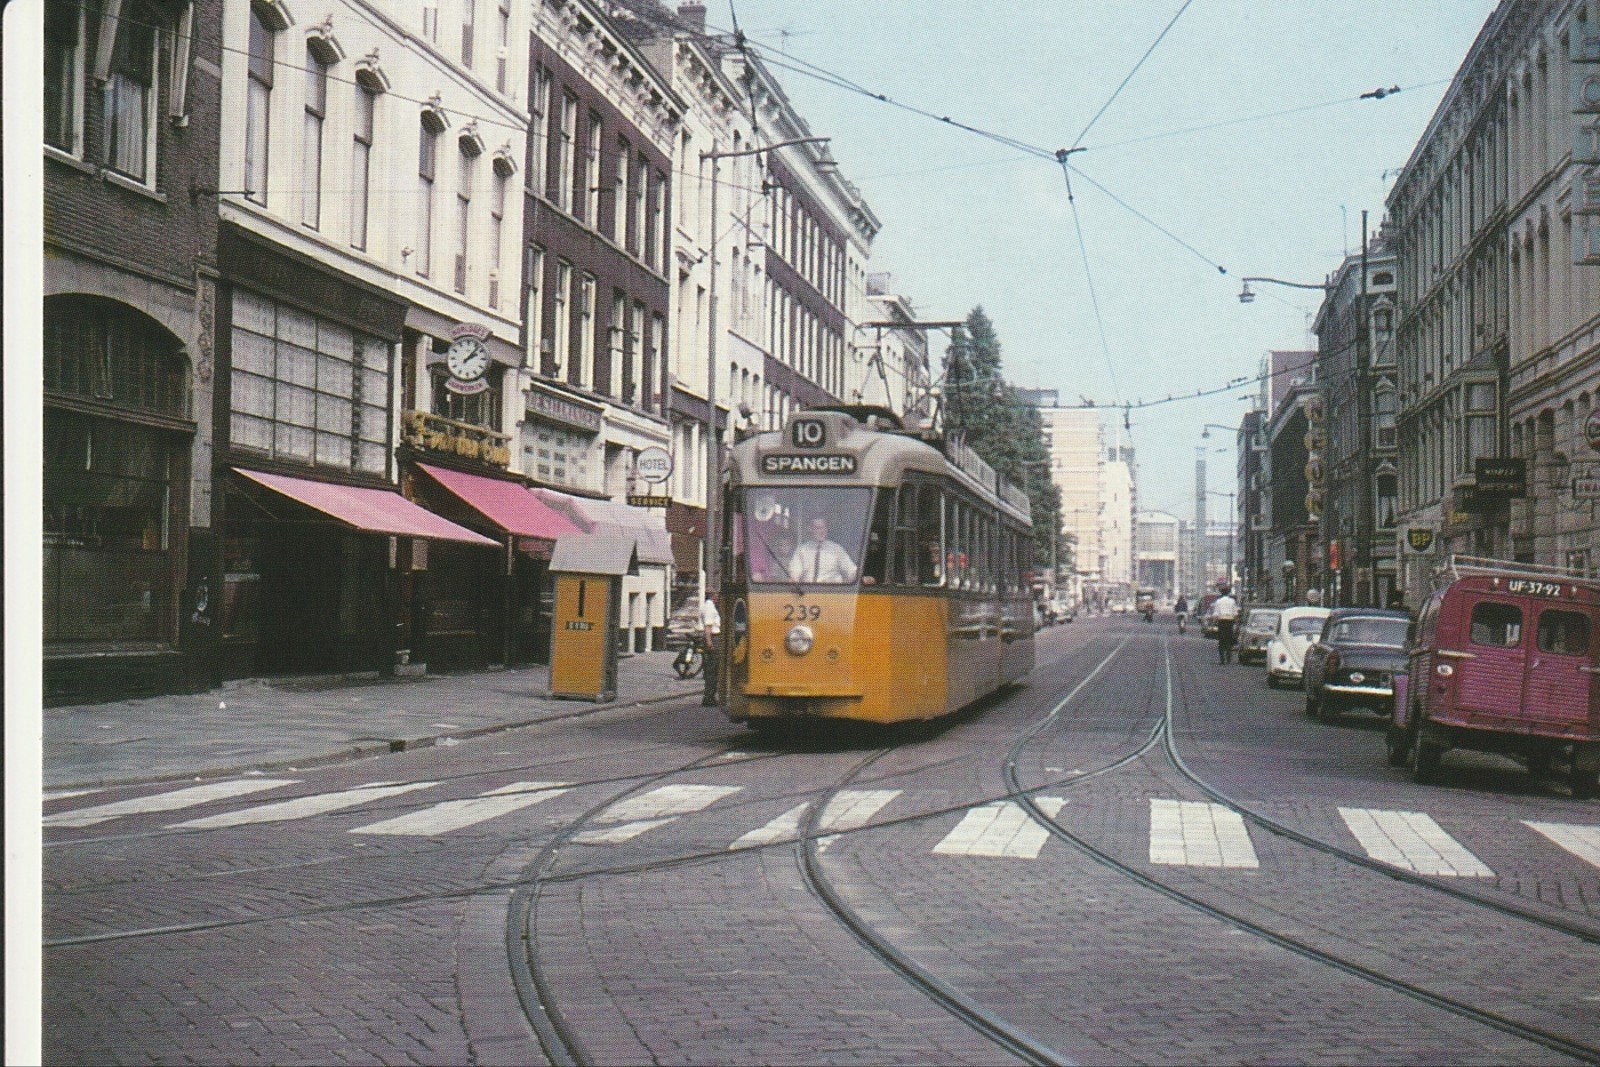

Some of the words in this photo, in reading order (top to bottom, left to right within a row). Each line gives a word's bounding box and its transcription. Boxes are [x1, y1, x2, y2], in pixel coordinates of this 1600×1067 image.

[797, 422, 822, 443] 10
[640, 459, 668, 471] HOTEL
[766, 456, 855, 471] SPANGEN
[630, 497, 668, 506] SERVICE
[1412, 533, 1430, 546] BP
[1509, 579, 1560, 597] UF-37-92
[784, 604, 821, 621] 239
